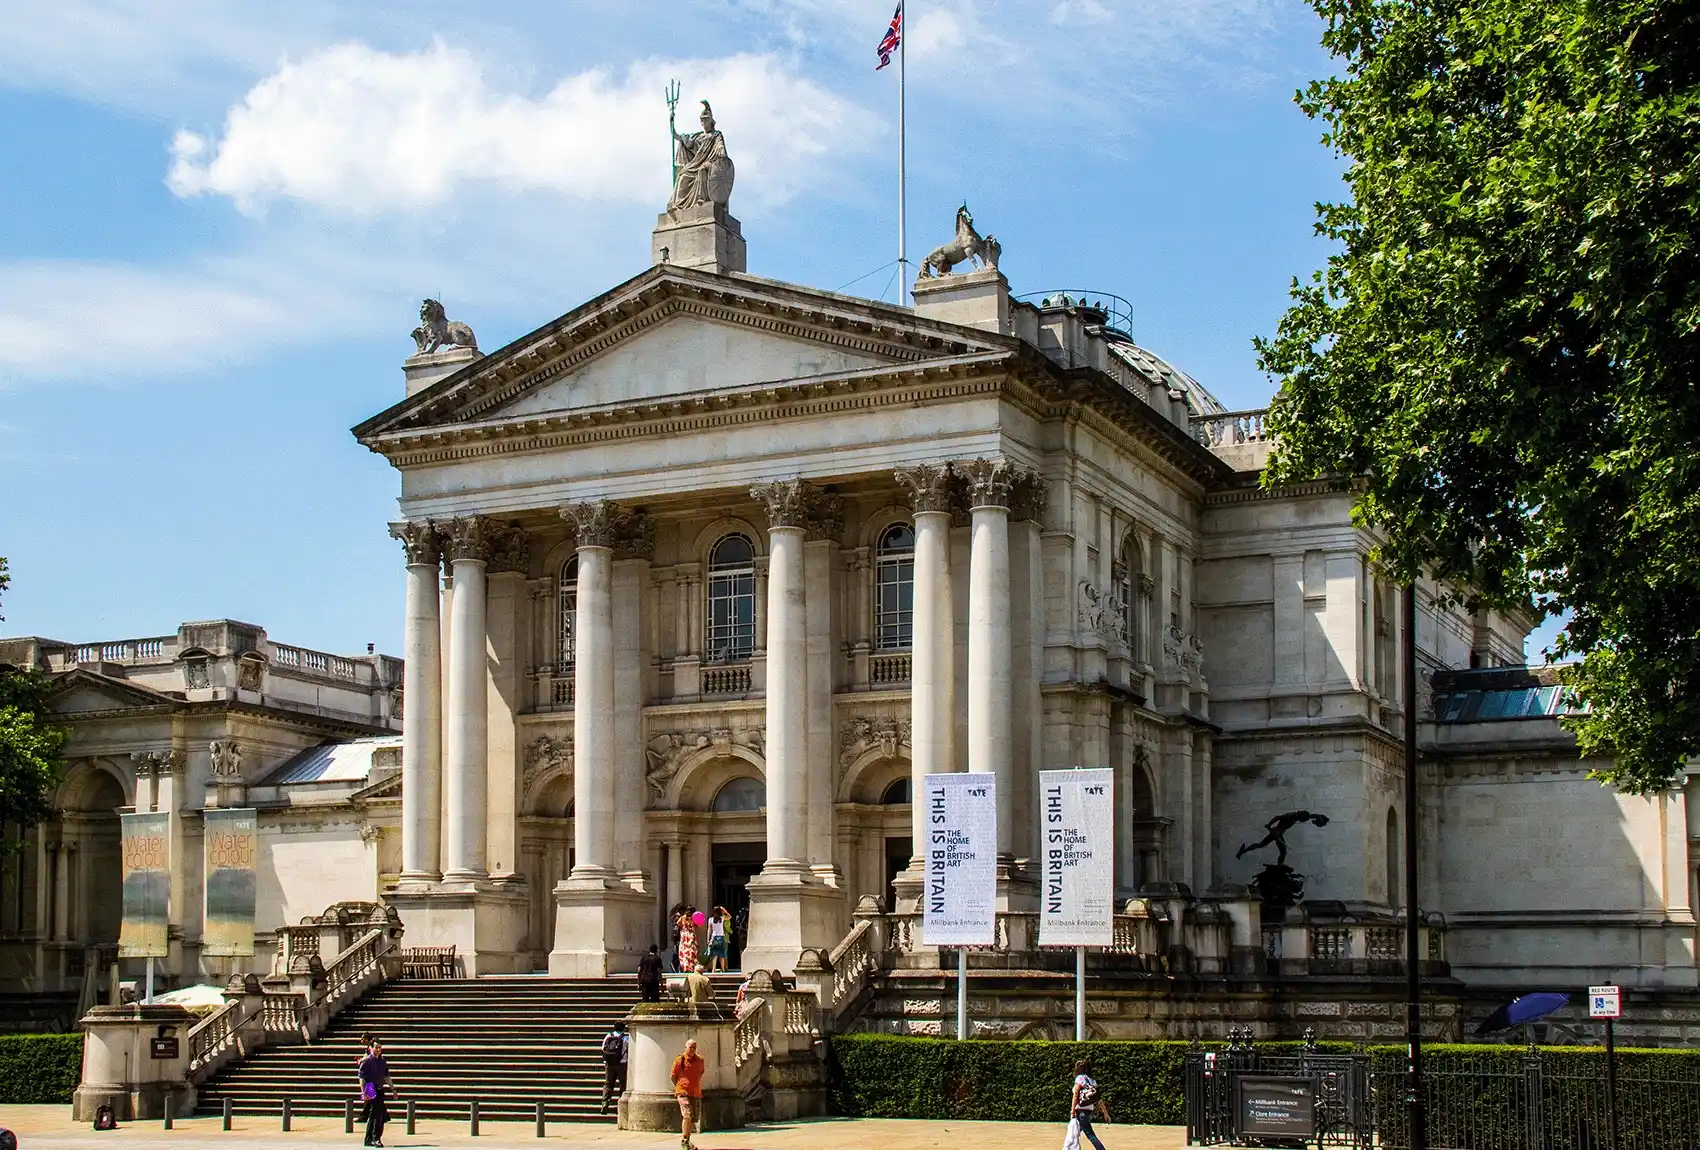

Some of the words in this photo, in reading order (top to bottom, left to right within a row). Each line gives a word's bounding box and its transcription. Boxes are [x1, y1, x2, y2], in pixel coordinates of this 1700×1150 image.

[968, 788, 986, 797] TATE
[1084, 787, 1104, 795] TATE
[932, 787, 945, 824] THIS
[1047, 785, 1062, 823] THIS
[209, 831, 252, 850] Water
[932, 830, 945, 844] IS
[947, 837, 970, 845] HOME
[1048, 829, 1062, 843] IS
[1064, 836, 1086, 844] HOME
[125, 835, 165, 853] Water
[1064, 844, 1074, 852] OF
[126, 853, 166, 868] coour
[210, 849, 254, 865] colour
[947, 852, 975, 860] BRITISH
[1064, 851, 1092, 859] BRITISH
[1064, 859, 1078, 867] ART
[931, 850, 945, 914] BRITAIN
[1048, 849, 1062, 914] BRITAIN
